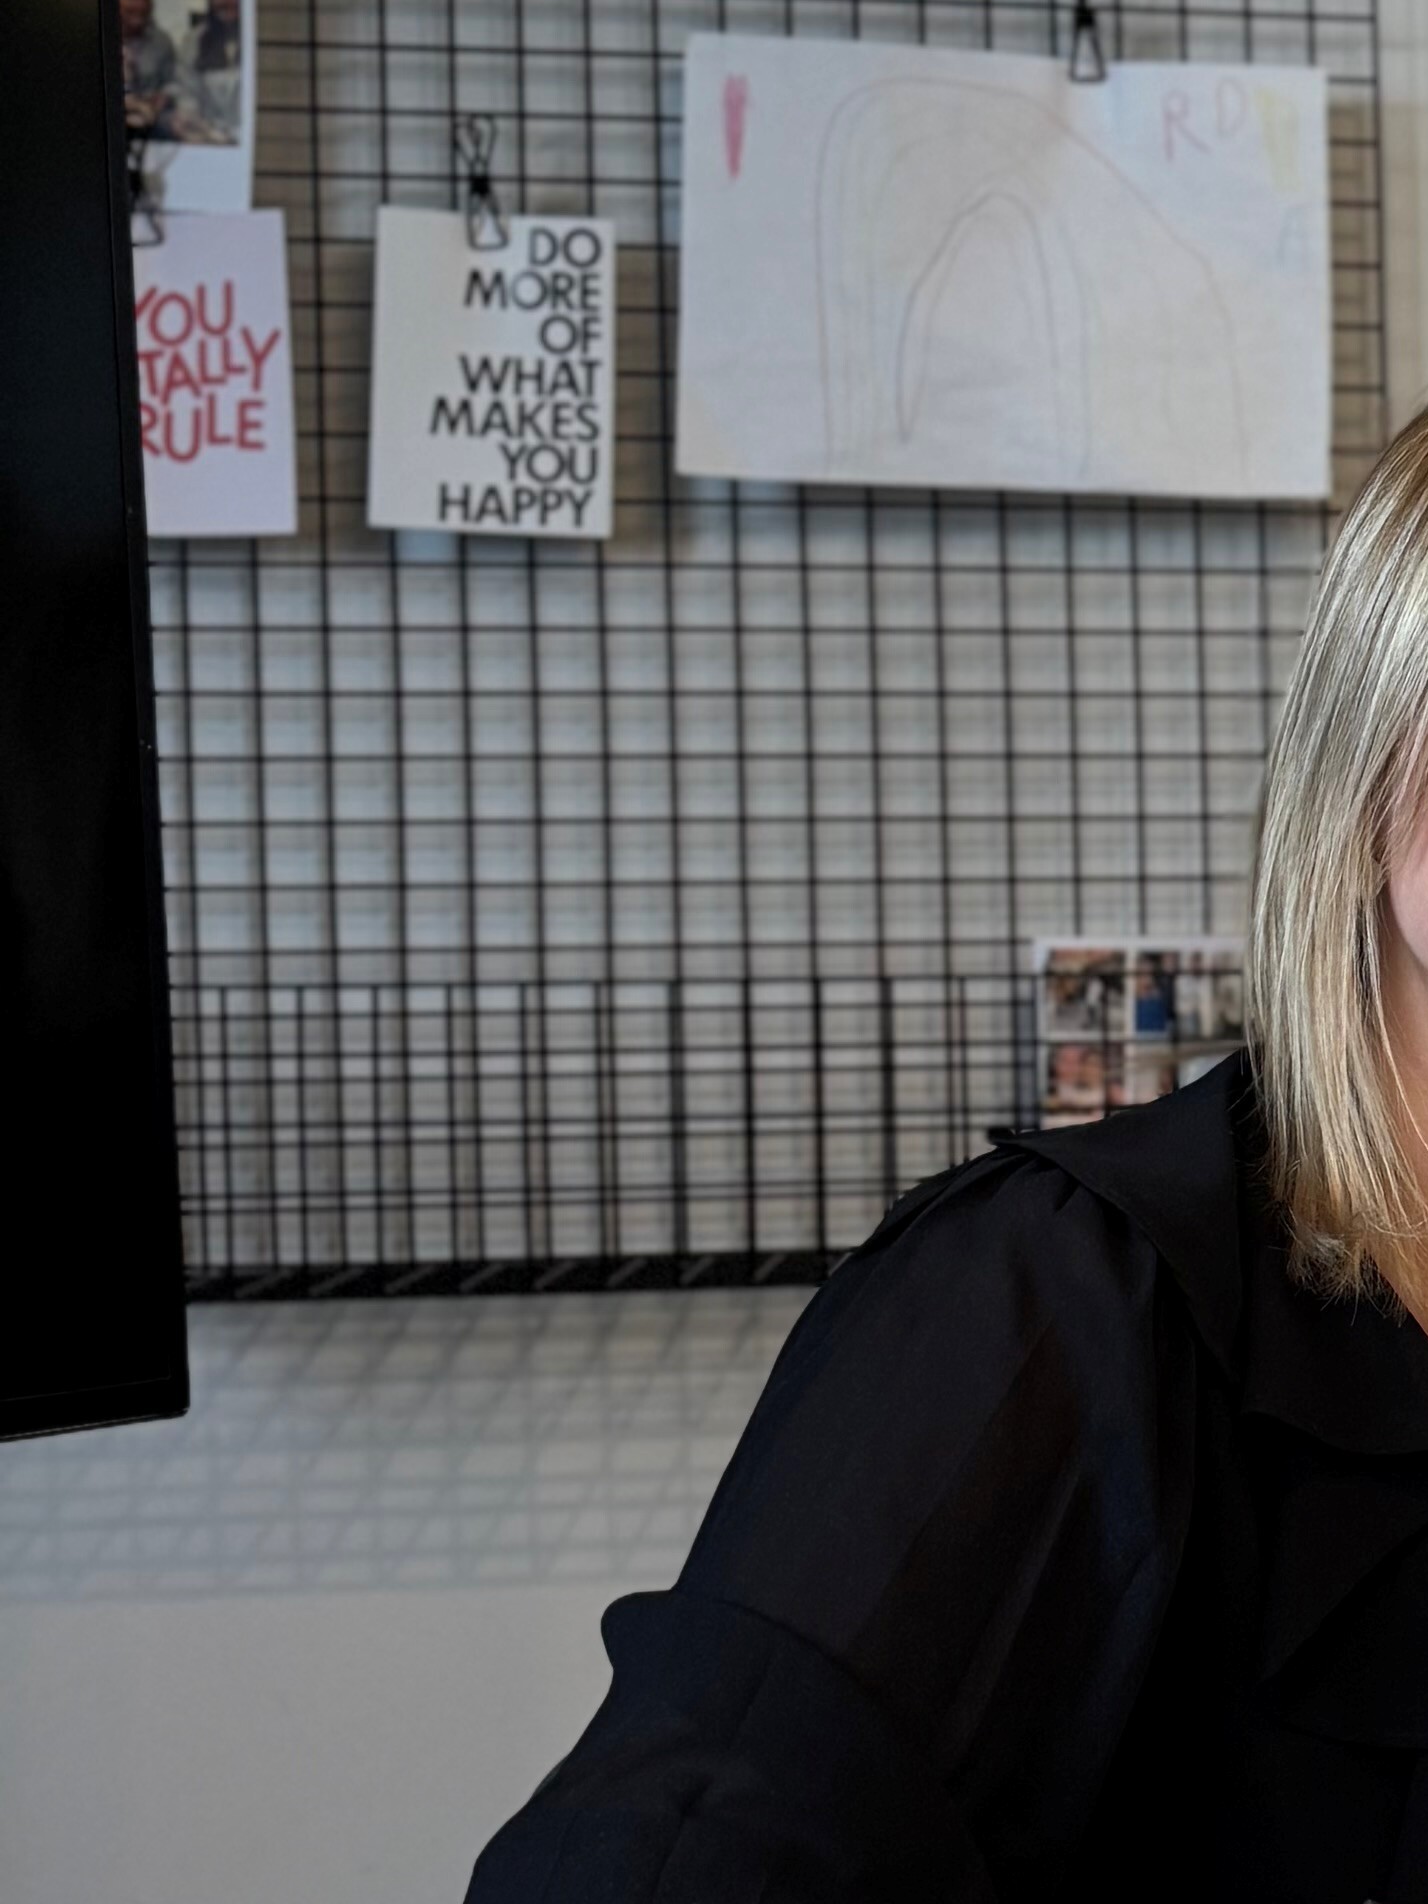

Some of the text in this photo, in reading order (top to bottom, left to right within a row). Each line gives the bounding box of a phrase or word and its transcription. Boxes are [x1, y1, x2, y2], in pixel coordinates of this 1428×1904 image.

[529, 227, 602, 268] DO
[464, 268, 602, 311] MORE
[539, 315, 602, 355] OF
[459, 352, 602, 397] WHAT
[430, 395, 600, 442] MAKES
[498, 440, 598, 484] YOU
[438, 480, 593, 527] HAPPY
